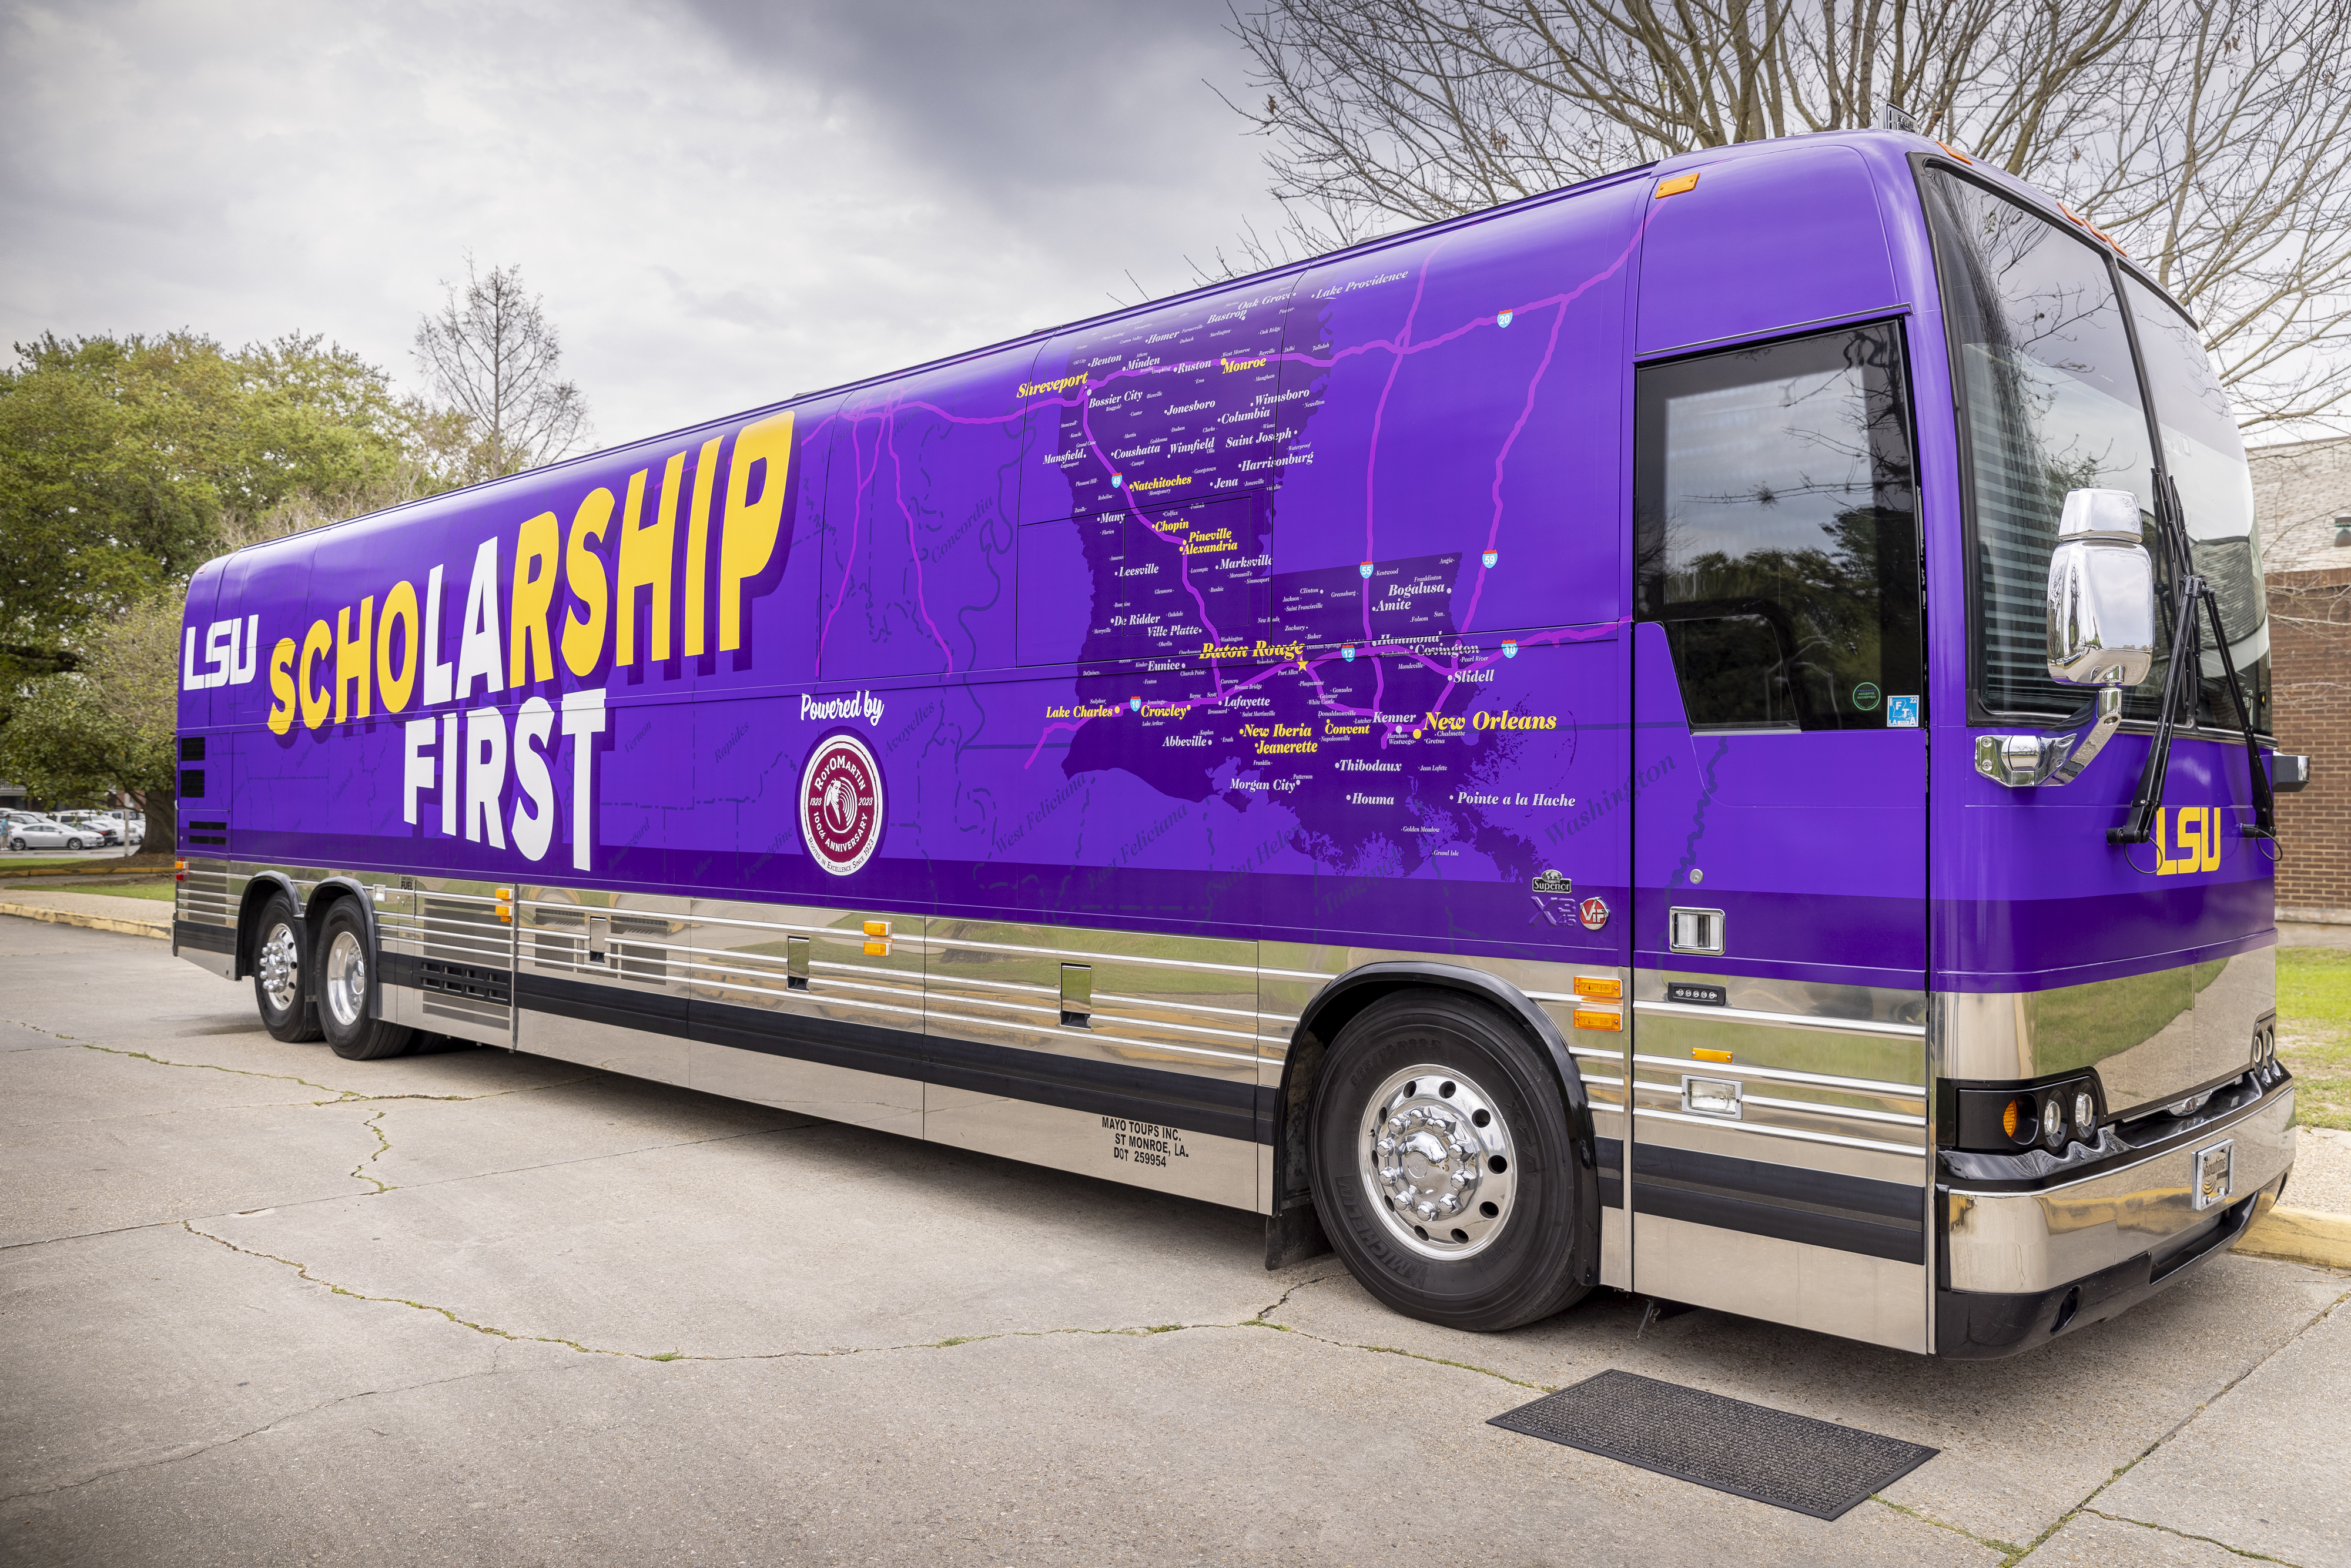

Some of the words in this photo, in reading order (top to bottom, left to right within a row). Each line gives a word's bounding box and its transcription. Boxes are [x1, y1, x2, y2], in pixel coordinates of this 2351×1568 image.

[1315, 285, 1343, 299] Lake
[1344, 271, 1408, 292] Providence
[1238, 299, 1259, 310] Oak
[1207, 309, 1247, 324] Bastrop
[1499, 314, 1510, 325] 20
[1181, 324, 1204, 333] Farmerville
[1147, 331, 1180, 344] Homer
[1090, 354, 1121, 367] Benton
[1126, 356, 1160, 370] Minden
[1177, 360, 1211, 374] Ruston
[1222, 358, 1266, 374] Monroe
[1016, 371, 1089, 398] Shreveport
[1089, 394, 1121, 408] Bossier
[1124, 390, 1143, 402] City
[1255, 389, 1310, 406] Winnsboro
[1167, 400, 1215, 416] Jonesboro
[1221, 407, 1270, 424] Columbia
[1225, 434, 1253, 448] Saint
[1256, 427, 1292, 444] Joseph
[1114, 444, 1161, 460] Coushatta
[1170, 437, 1215, 454] Winnfield
[1043, 448, 1084, 465] Mansfield
[1241, 451, 1314, 471] Harrisonburg
[1113, 477, 1120, 485] 49
[1131, 475, 1192, 492] Natchitoches
[1214, 477, 1238, 489] Jena
[1100, 512, 1125, 524] Many
[1155, 518, 1189, 532] Chopin
[932, 495, 994, 564] Concordia
[1188, 528, 1233, 544] Pineville
[1182, 540, 1238, 555] Alexandria
[1219, 554, 1273, 571] Marksville
[1484, 555, 1495, 565] 59
[267, 410, 795, 735] SCHOLARSHIP
[1118, 563, 1159, 578] Leesville
[1362, 567, 1371, 575] 55
[1388, 582, 1445, 598] Bogalusa
[1375, 598, 1411, 612] Amite
[1114, 617, 1127, 626] De
[1129, 615, 1161, 626] Ridder
[1147, 626, 1168, 637] Ville
[1170, 625, 1199, 636] Platte
[183, 614, 259, 691] LSU
[1199, 644, 1248, 659] Baton
[1252, 640, 1306, 660] Rouge
[1343, 649, 1353, 658] 12
[1415, 642, 1481, 658] Covington
[1505, 645, 1516, 654] 10
[1148, 659, 1180, 671] Eunice
[1453, 669, 1495, 683] Slidell
[801, 690, 862, 721] Powered
[864, 690, 885, 726] by
[1224, 695, 1270, 709] Lafayette
[1046, 706, 1070, 718] Lake
[1073, 705, 1113, 718] Charles
[1141, 704, 1187, 720] Crowley
[1372, 712, 1416, 723] Kenner
[1423, 712, 1466, 731] New
[1472, 711, 1558, 731] Orleans
[1243, 724, 1270, 737] New
[1272, 723, 1312, 737] Iberia
[1325, 723, 1370, 735] Convent
[1162, 736, 1207, 747] Abbeville
[1257, 740, 1318, 754] Jeanerette
[1339, 759, 1402, 772] Thibodaux
[404, 688, 607, 872] FIRST
[1230, 778, 1270, 792] Morgan
[1273, 779, 1295, 793] City
[810, 797, 822, 806] 1923
[858, 797, 873, 806] 2023
[1352, 793, 1395, 805] Houma
[1457, 792, 1499, 805] Pointe
[1502, 796, 1511, 805] a
[1515, 793, 1529, 805] la
[1532, 793, 1576, 806] Hache
[813, 811, 826, 839] 100th
[825, 812, 868, 852] ANNIVERSARY
[863, 839, 874, 856] 1923
[2156, 807, 2221, 876] LSU
[401, 881, 413, 890] FUEL
[1534, 880, 1569, 892] Superior
[1102, 1117, 1126, 1131] MAYO
[1129, 1121, 1159, 1137] TOURS
[1163, 1127, 1181, 1141] INC.
[1115, 1133, 1126, 1145] ST
[1129, 1135, 1171, 1157] MONROE,
[1175, 1143, 1189, 1157] LA.
[1114, 1147, 1128, 1161] DOT
[1134, 1151, 1166, 1168] 259954
[1337, 1177, 1418, 1276] MICHELIN
